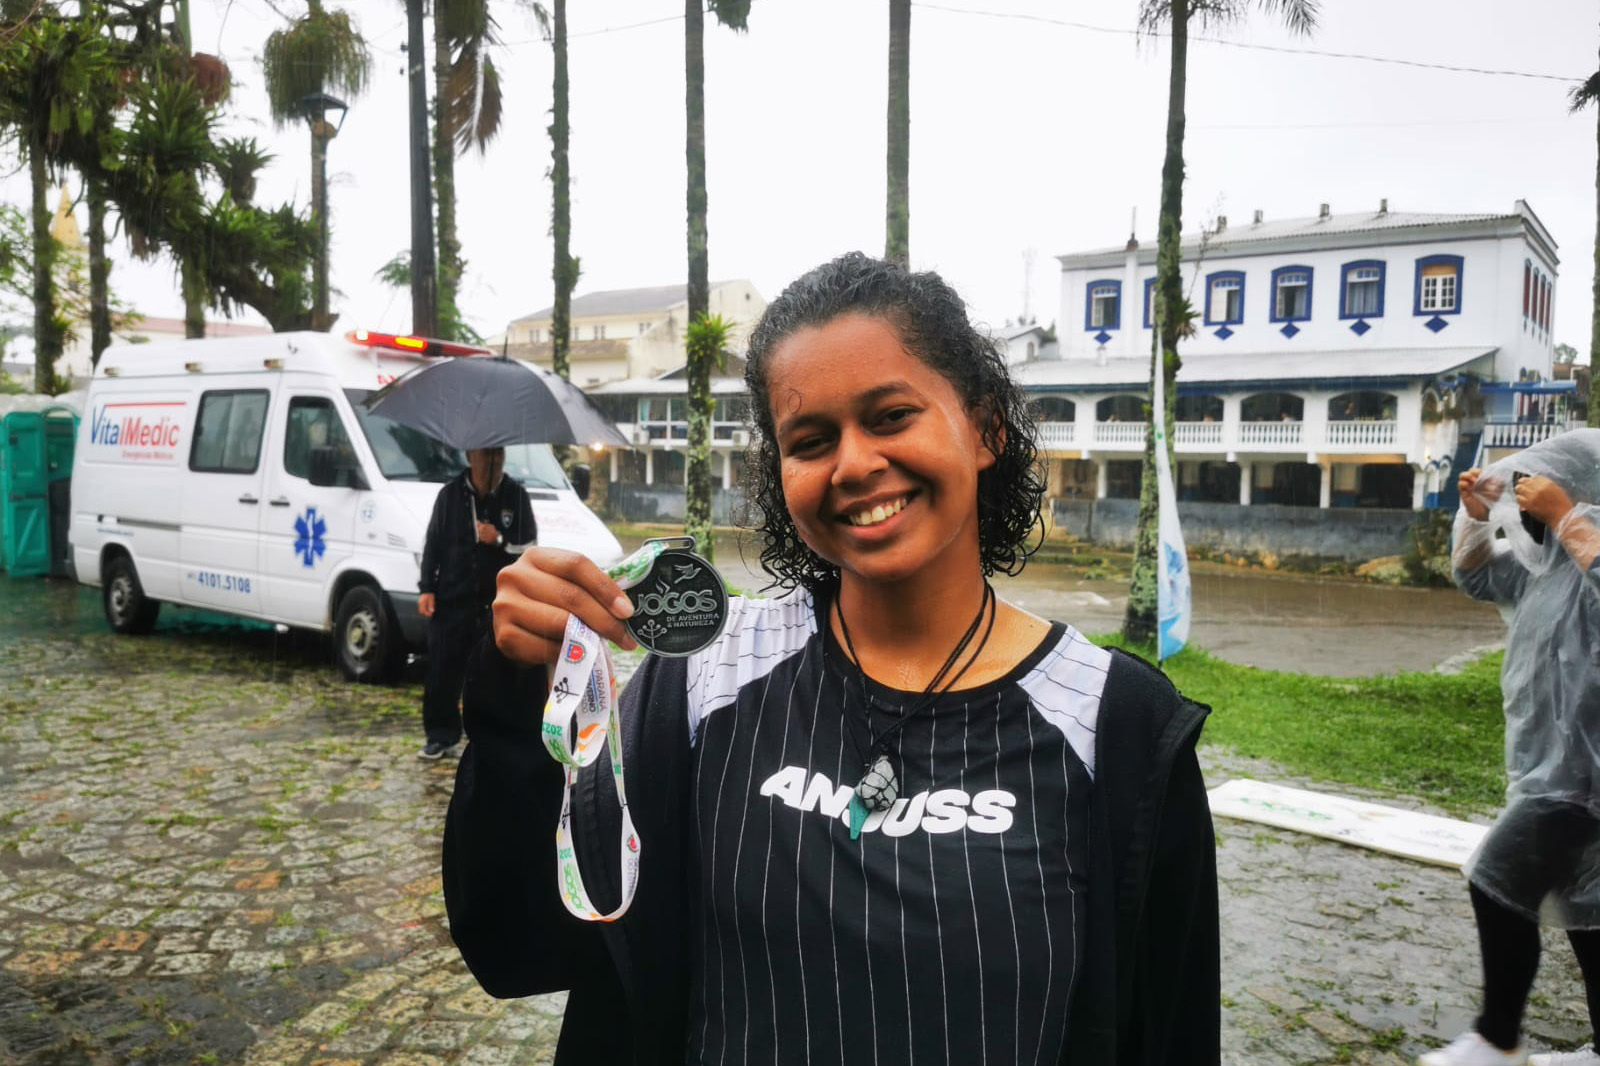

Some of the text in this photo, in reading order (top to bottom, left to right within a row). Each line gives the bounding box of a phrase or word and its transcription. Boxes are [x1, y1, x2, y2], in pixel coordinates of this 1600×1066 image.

[91, 404, 180, 447] VitalMedic
[198, 572, 251, 593] 4101.5108
[634, 589, 717, 616] JOGOS
[674, 620, 714, 628] NATUREZA
[679, 613, 719, 621] AVENTURA
